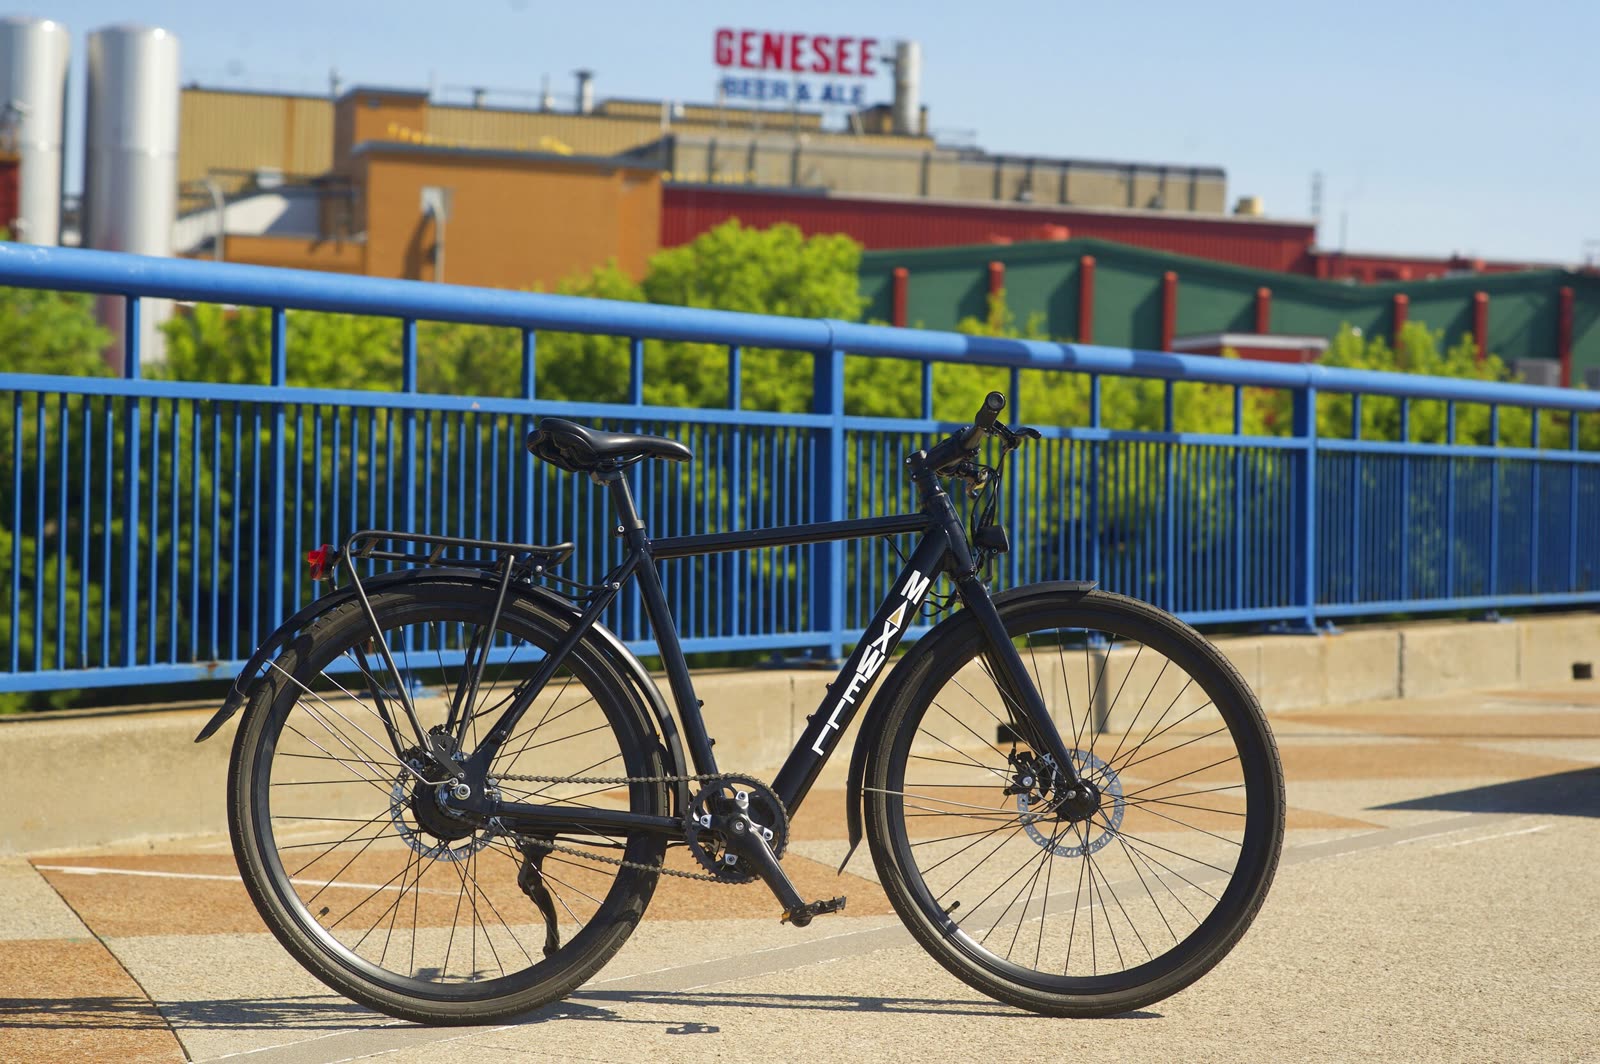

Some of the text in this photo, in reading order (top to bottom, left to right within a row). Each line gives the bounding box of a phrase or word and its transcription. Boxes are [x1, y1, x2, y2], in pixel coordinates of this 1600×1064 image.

[714, 29, 878, 76] GENESEE
[721, 77, 864, 106] BEER & ALE
[811, 569, 931, 757] MAXWELL
